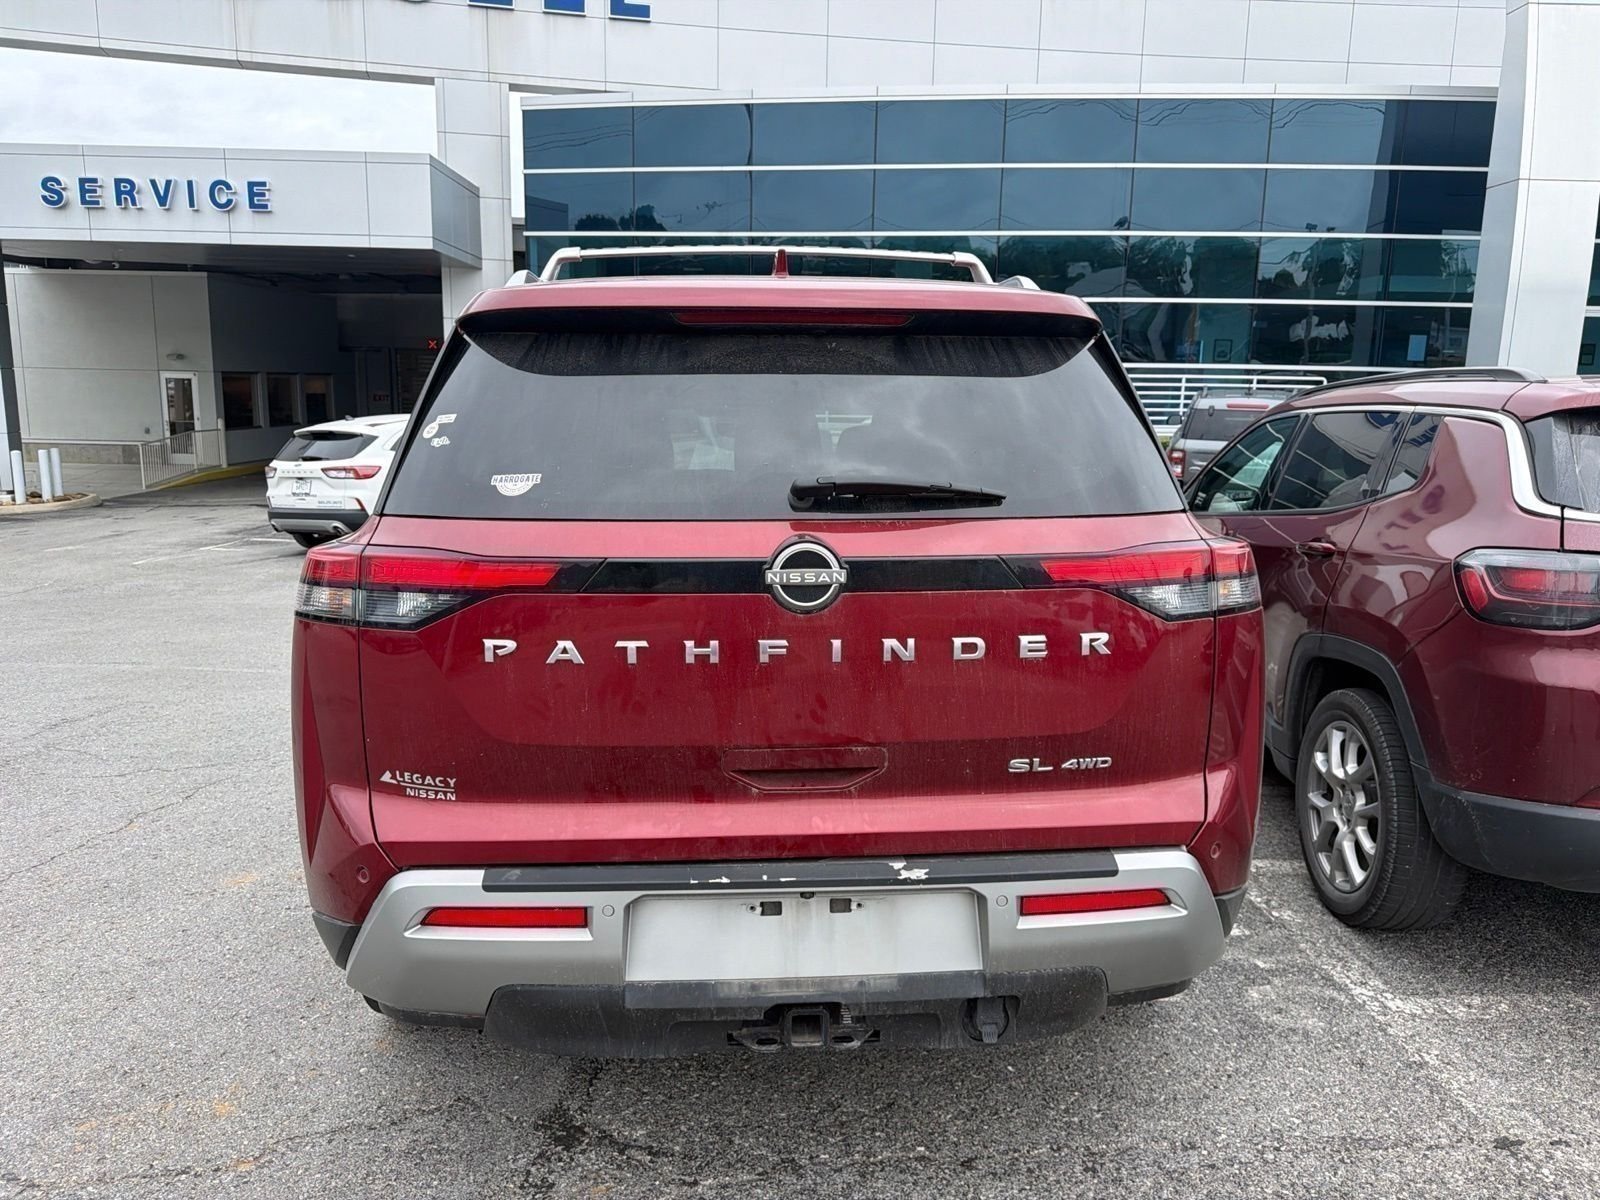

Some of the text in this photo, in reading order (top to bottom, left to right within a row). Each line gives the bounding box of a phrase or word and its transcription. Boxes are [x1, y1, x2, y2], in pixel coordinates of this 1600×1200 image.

[40, 175, 273, 213] SERVICE
[492, 475, 541, 484] HARROGATE
[767, 572, 845, 583] NISSAN
[482, 631, 1113, 665] PATHFINDER
[1008, 757, 1112, 773] SL 4WD
[395, 770, 457, 787] LEGACY
[406, 788, 456, 801] NISSAN
